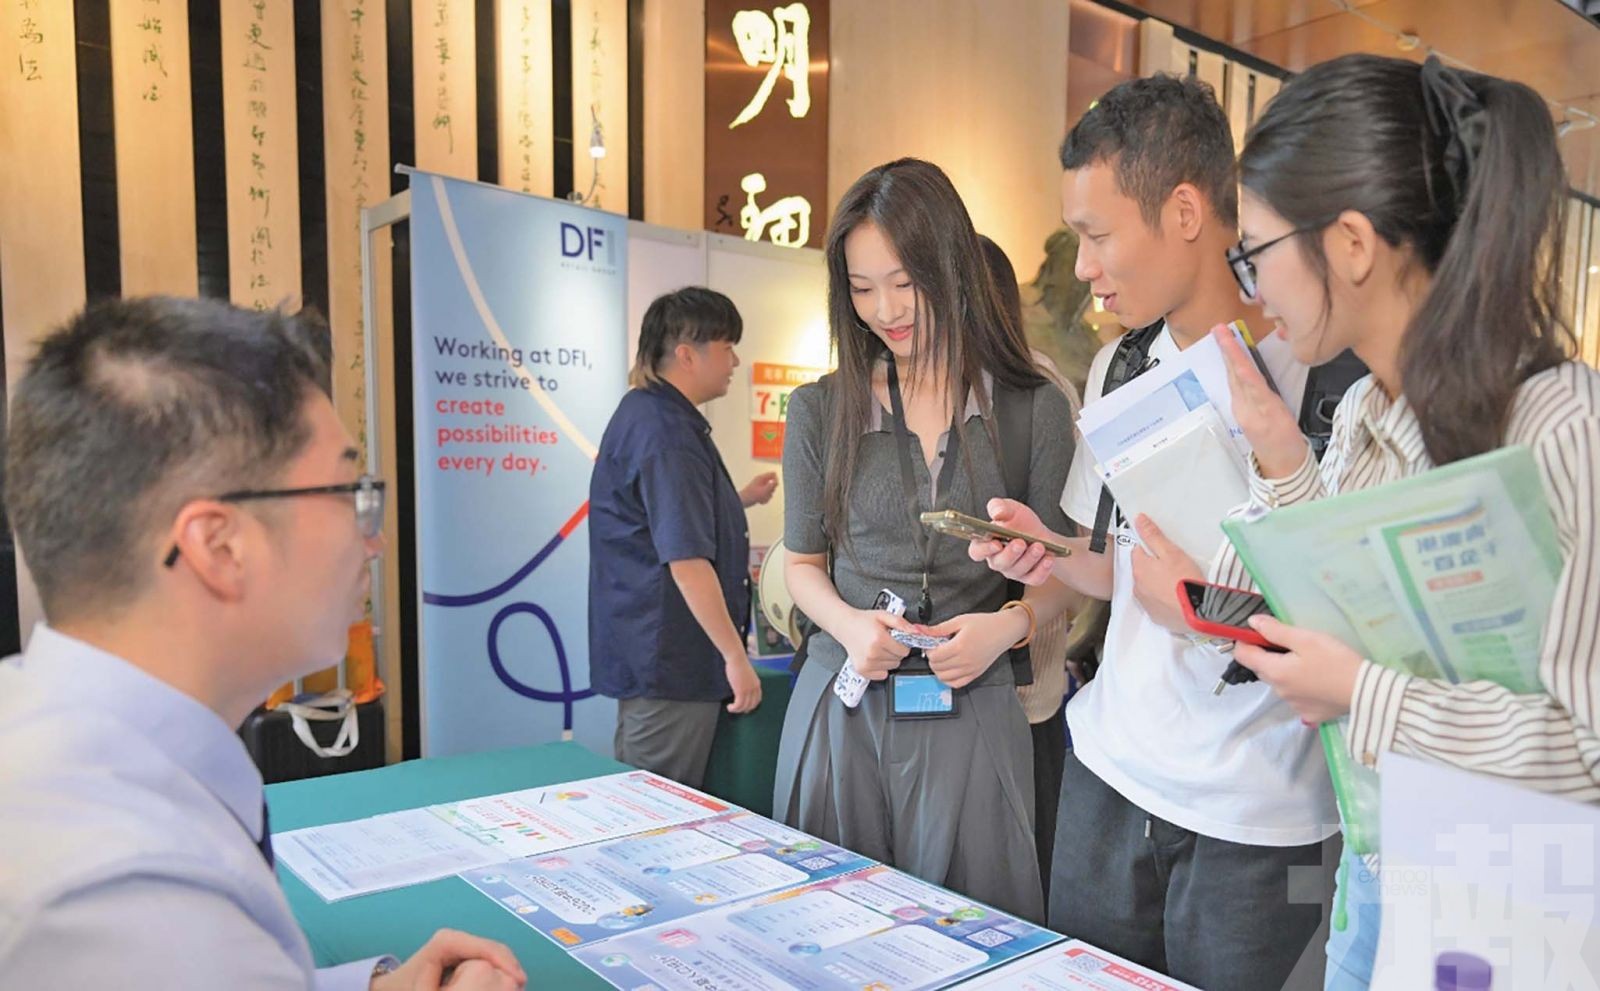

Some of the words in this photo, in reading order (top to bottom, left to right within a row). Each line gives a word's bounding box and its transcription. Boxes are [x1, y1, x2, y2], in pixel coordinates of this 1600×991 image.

[560, 221, 617, 267] DFI
[434, 336, 522, 367] Working
[530, 349, 552, 365] at
[558, 348, 592, 370] DFI,
[435, 370, 467, 386] we
[473, 372, 531, 390] strive
[539, 376, 559, 392] to
[436, 398, 505, 416] create
[437, 425, 559, 447] possibilities
[437, 454, 495, 476] every
[501, 453, 547, 476] day.
